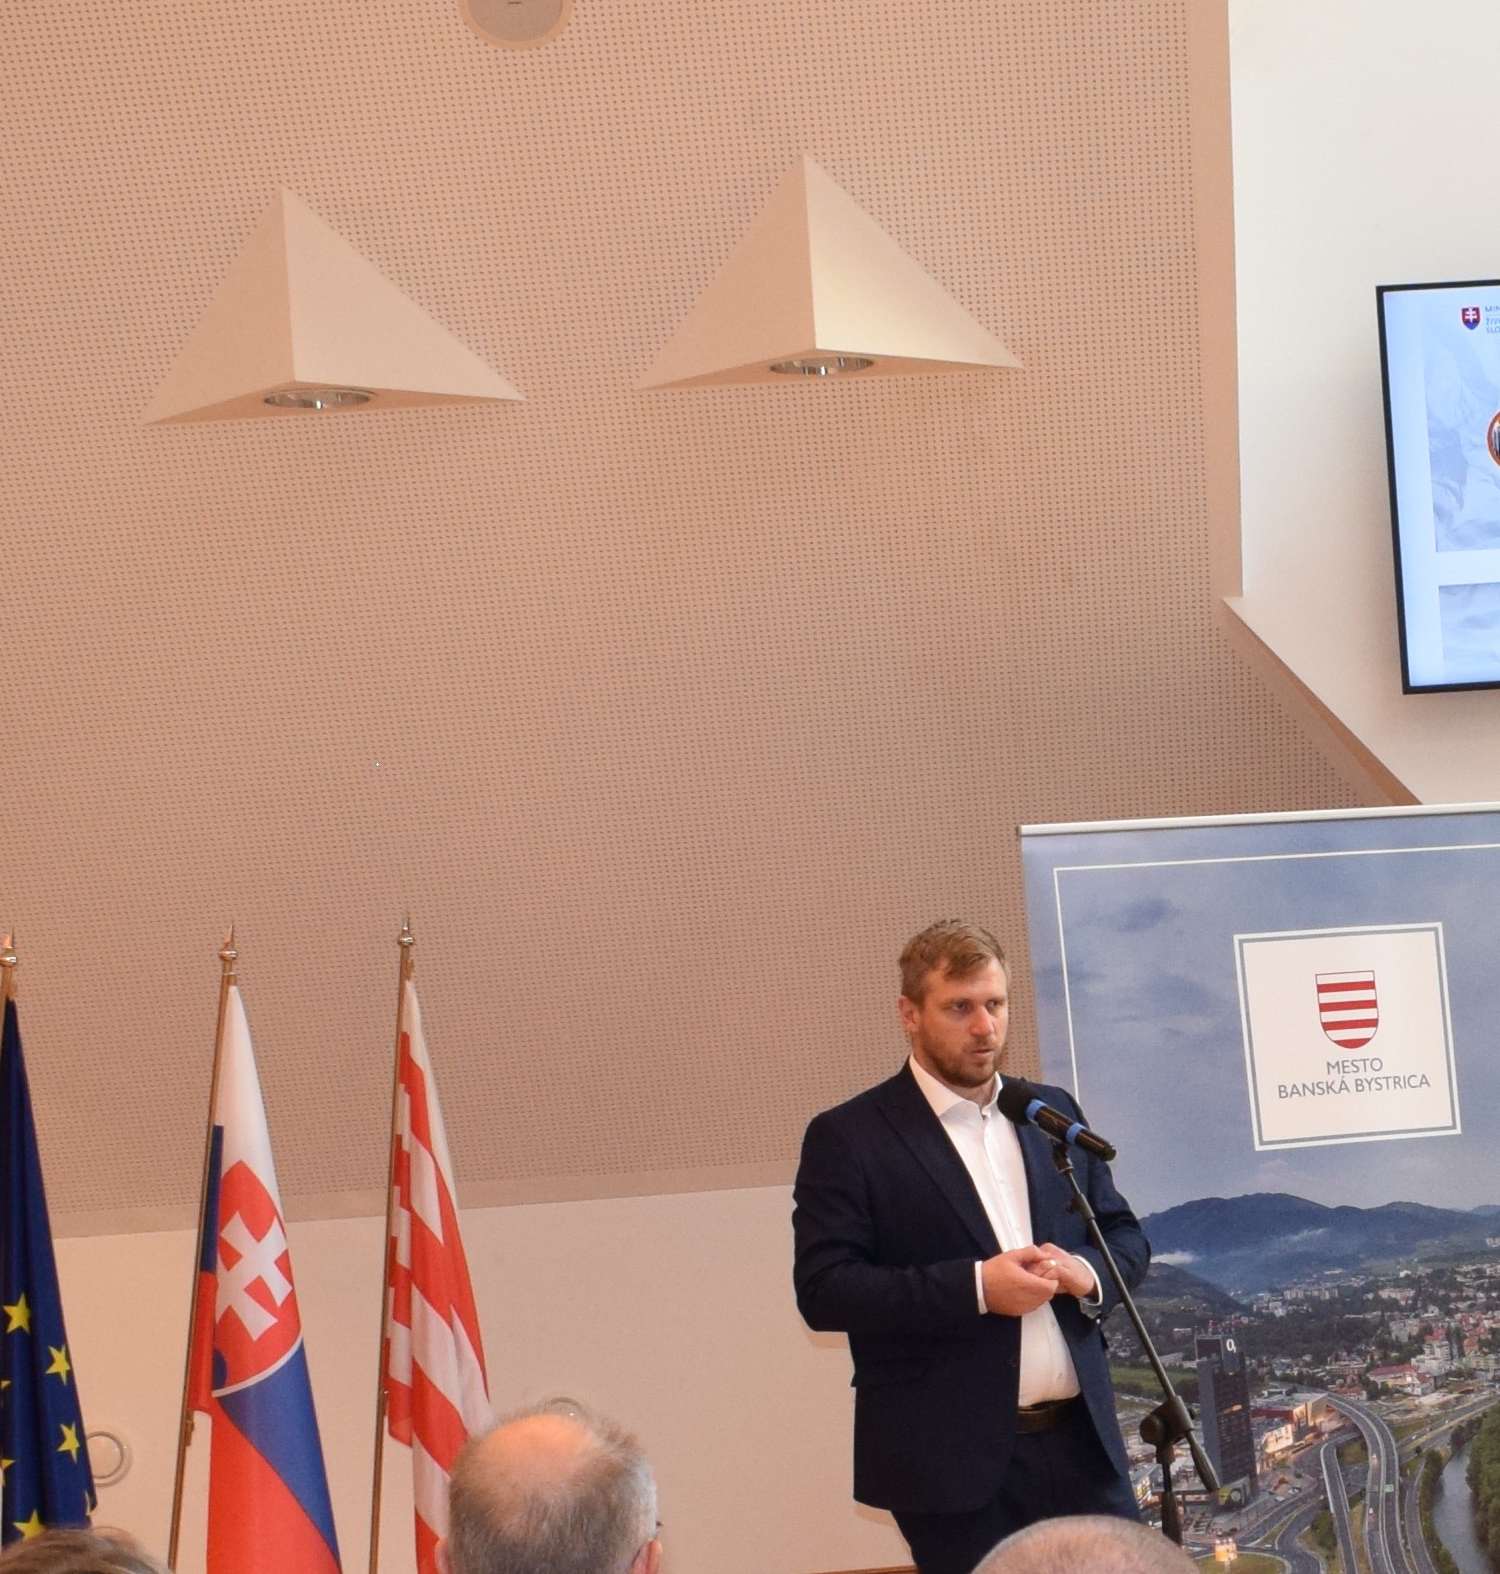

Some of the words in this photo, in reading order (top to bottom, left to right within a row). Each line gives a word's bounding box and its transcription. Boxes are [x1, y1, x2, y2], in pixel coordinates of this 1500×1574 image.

[1326, 1058, 1383, 1075] MESTO
[1277, 1075, 1350, 1099] BANSKÁ
[1355, 1074, 1431, 1092] BYSTRICA
